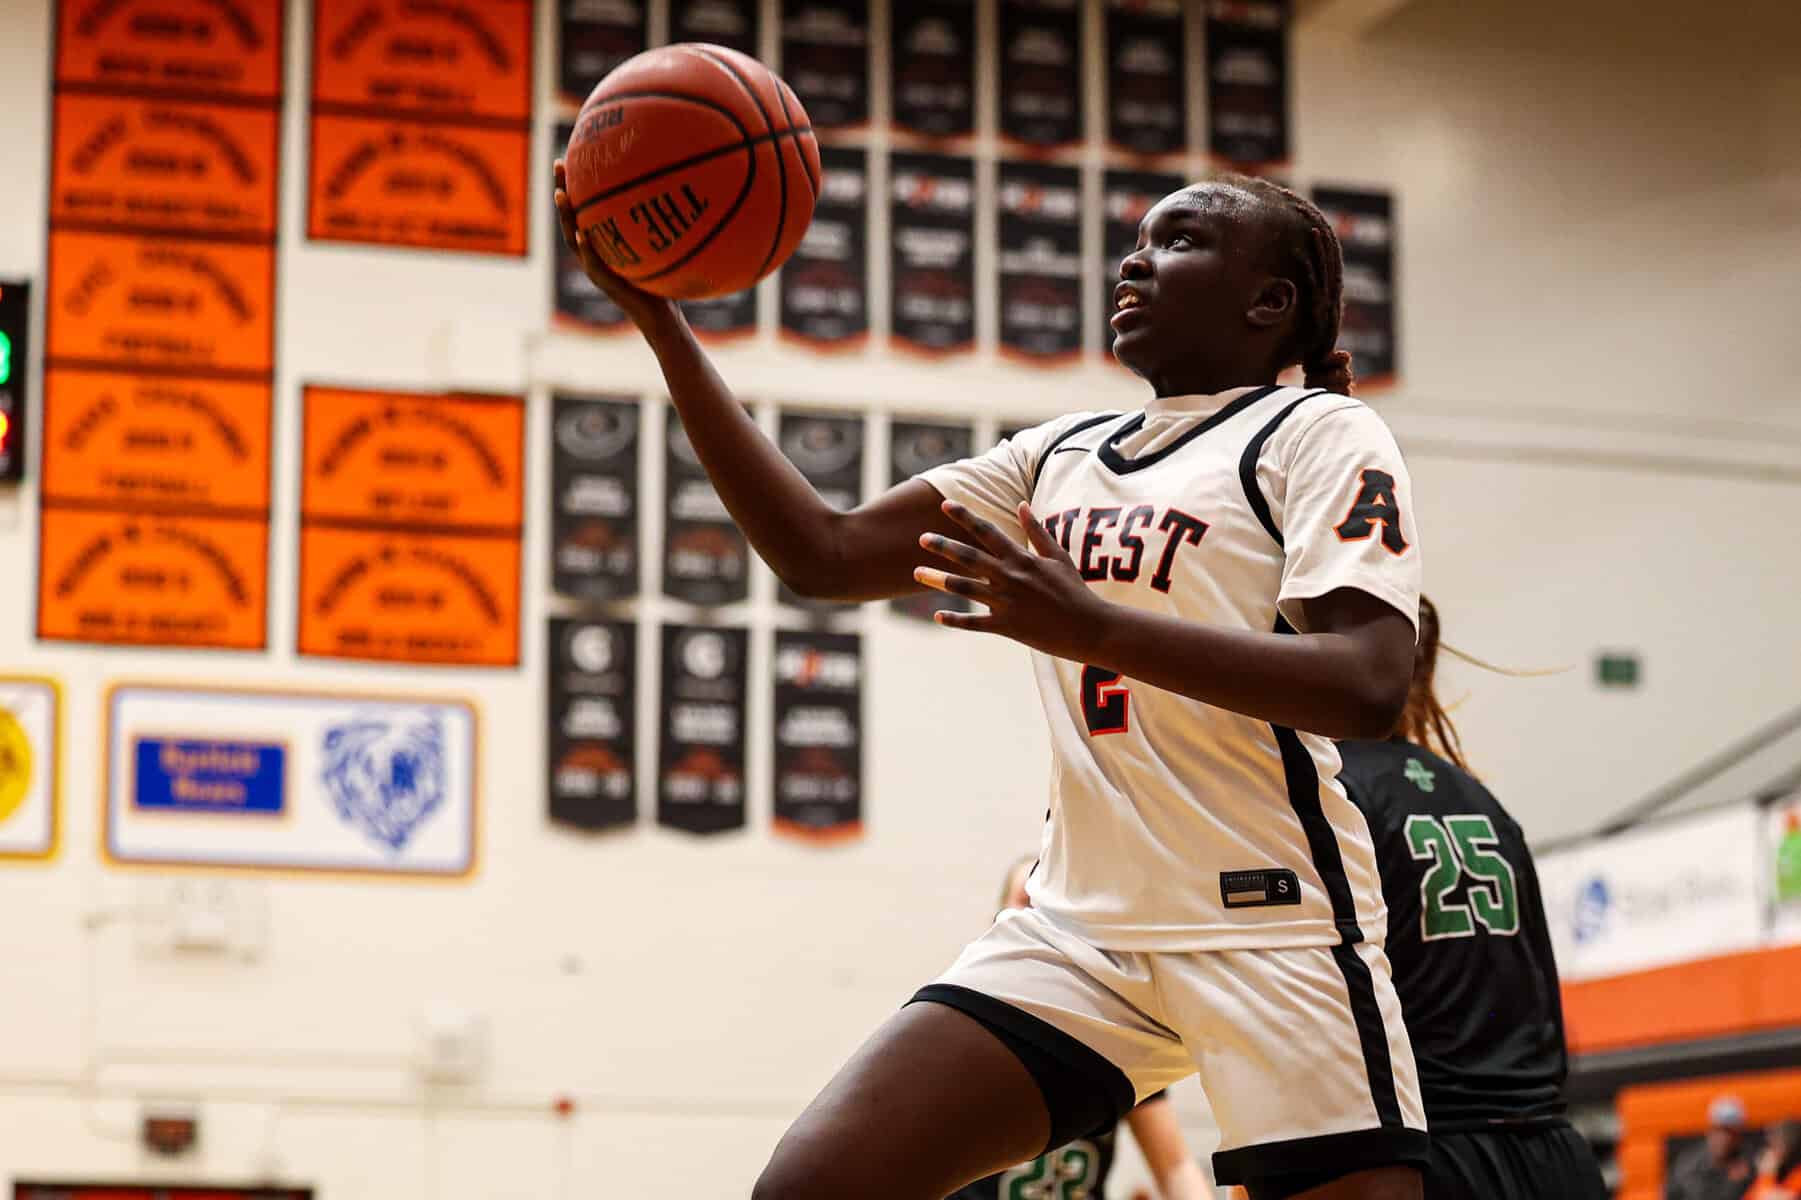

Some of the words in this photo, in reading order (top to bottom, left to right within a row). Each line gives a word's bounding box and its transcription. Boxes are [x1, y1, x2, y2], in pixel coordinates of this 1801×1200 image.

[631, 183, 709, 253] THE
[1332, 467, 1411, 557] A
[1277, 879, 1289, 894] S
[1403, 814, 1520, 942] 25
